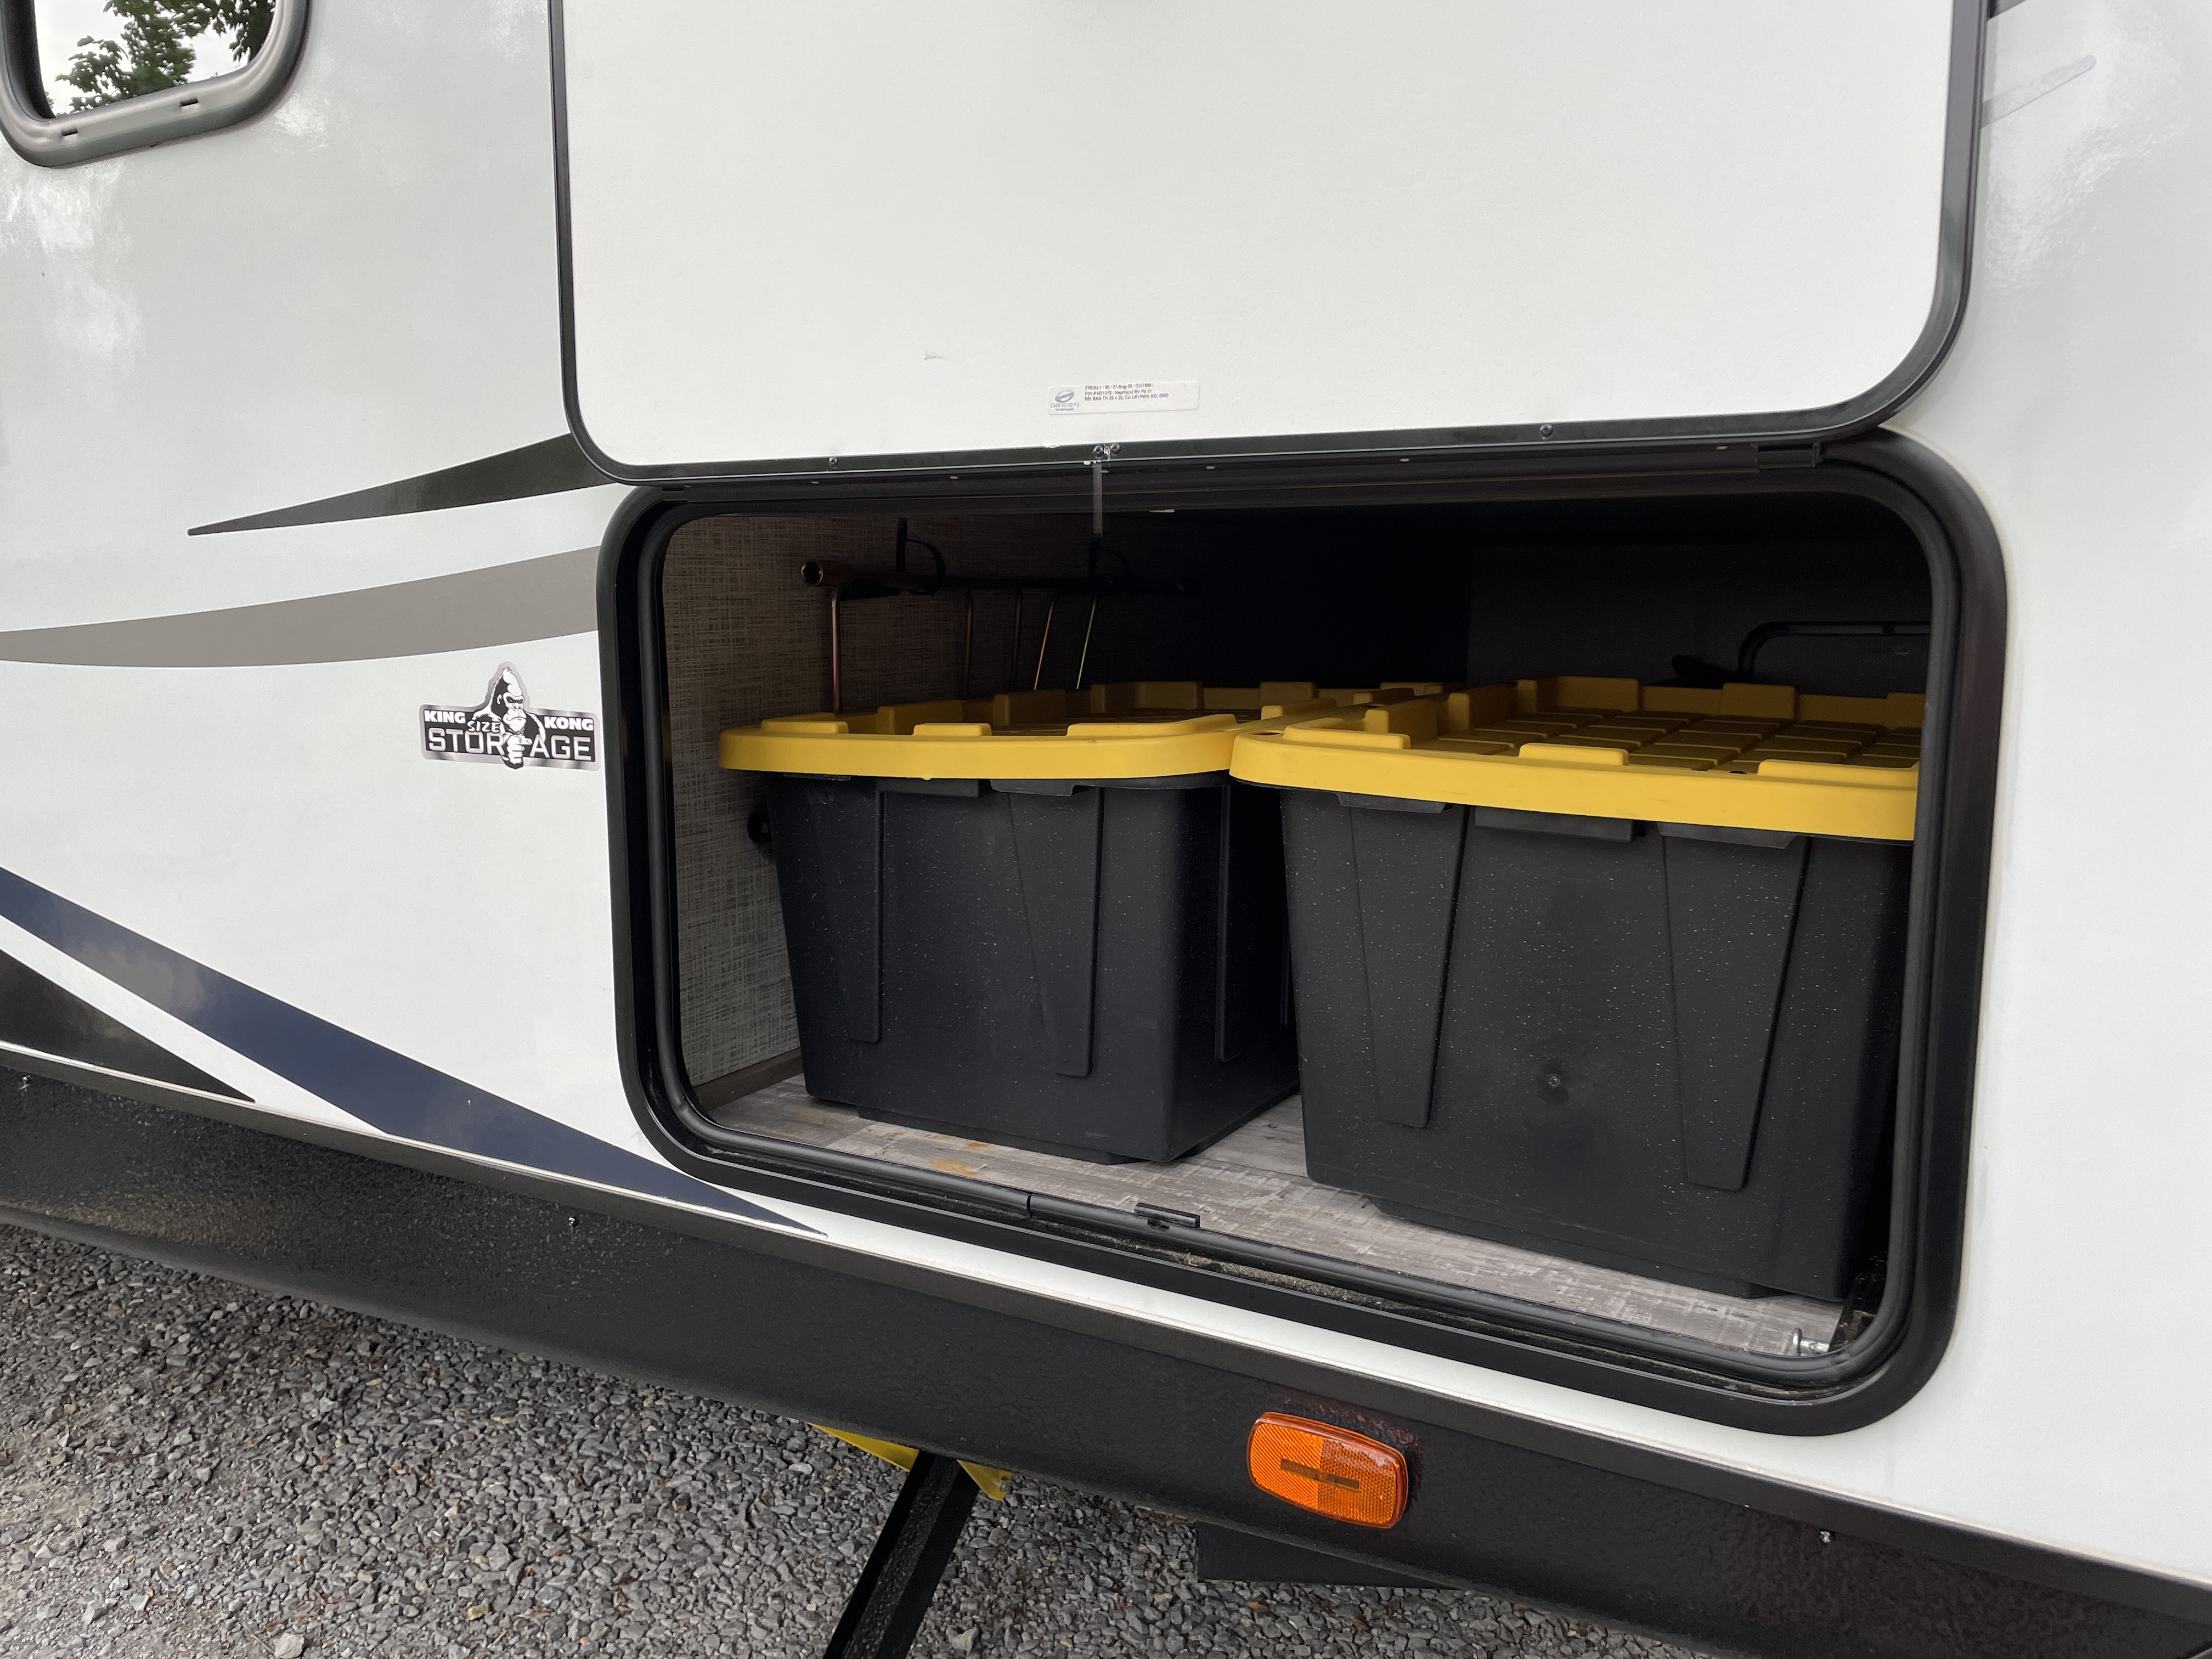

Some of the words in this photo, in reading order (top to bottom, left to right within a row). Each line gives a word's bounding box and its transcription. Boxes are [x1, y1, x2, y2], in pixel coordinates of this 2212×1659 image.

[425, 710, 465, 724] KING
[544, 716, 594, 731] KONG
[467, 720, 501, 733] SIZE
